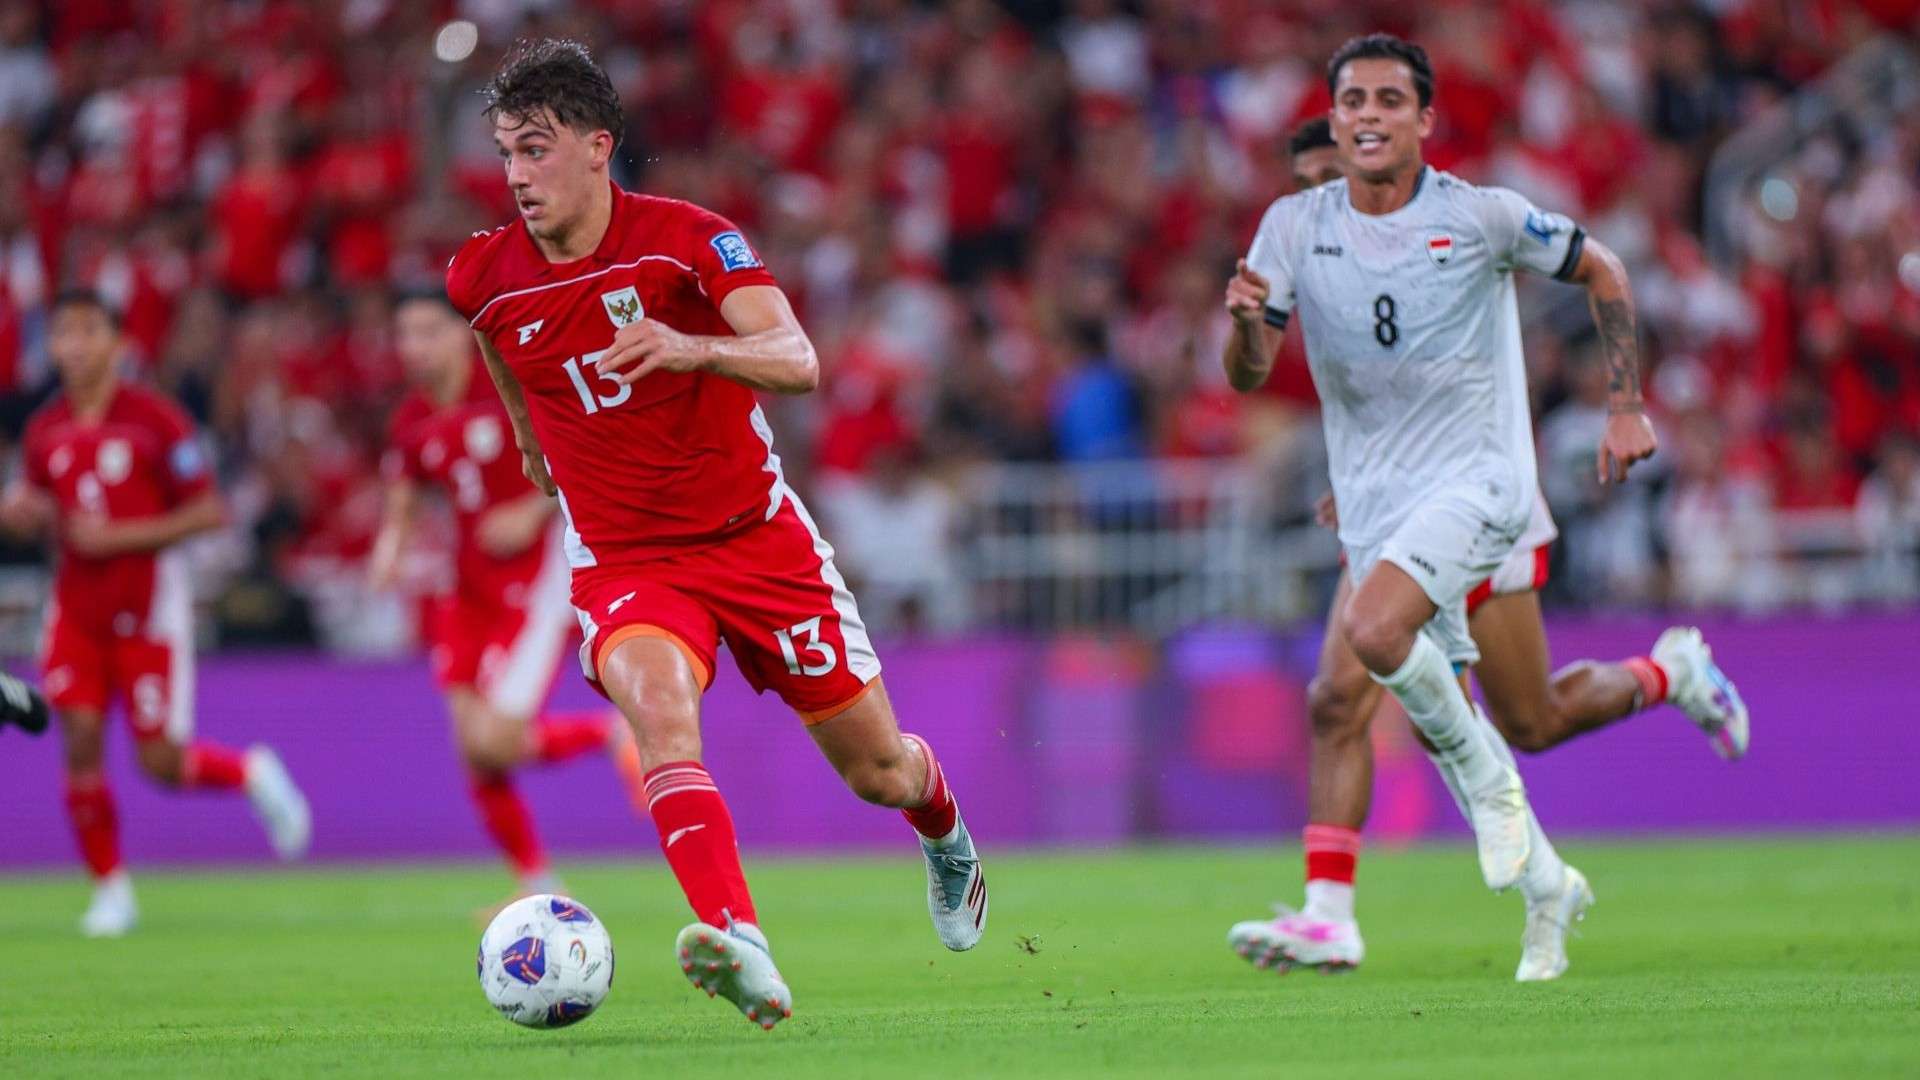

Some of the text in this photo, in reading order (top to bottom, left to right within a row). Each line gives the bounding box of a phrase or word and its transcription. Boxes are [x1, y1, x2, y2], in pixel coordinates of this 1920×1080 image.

[1373, 293, 1399, 348] 8
[562, 349, 632, 415] 13
[773, 615, 838, 677] 13
